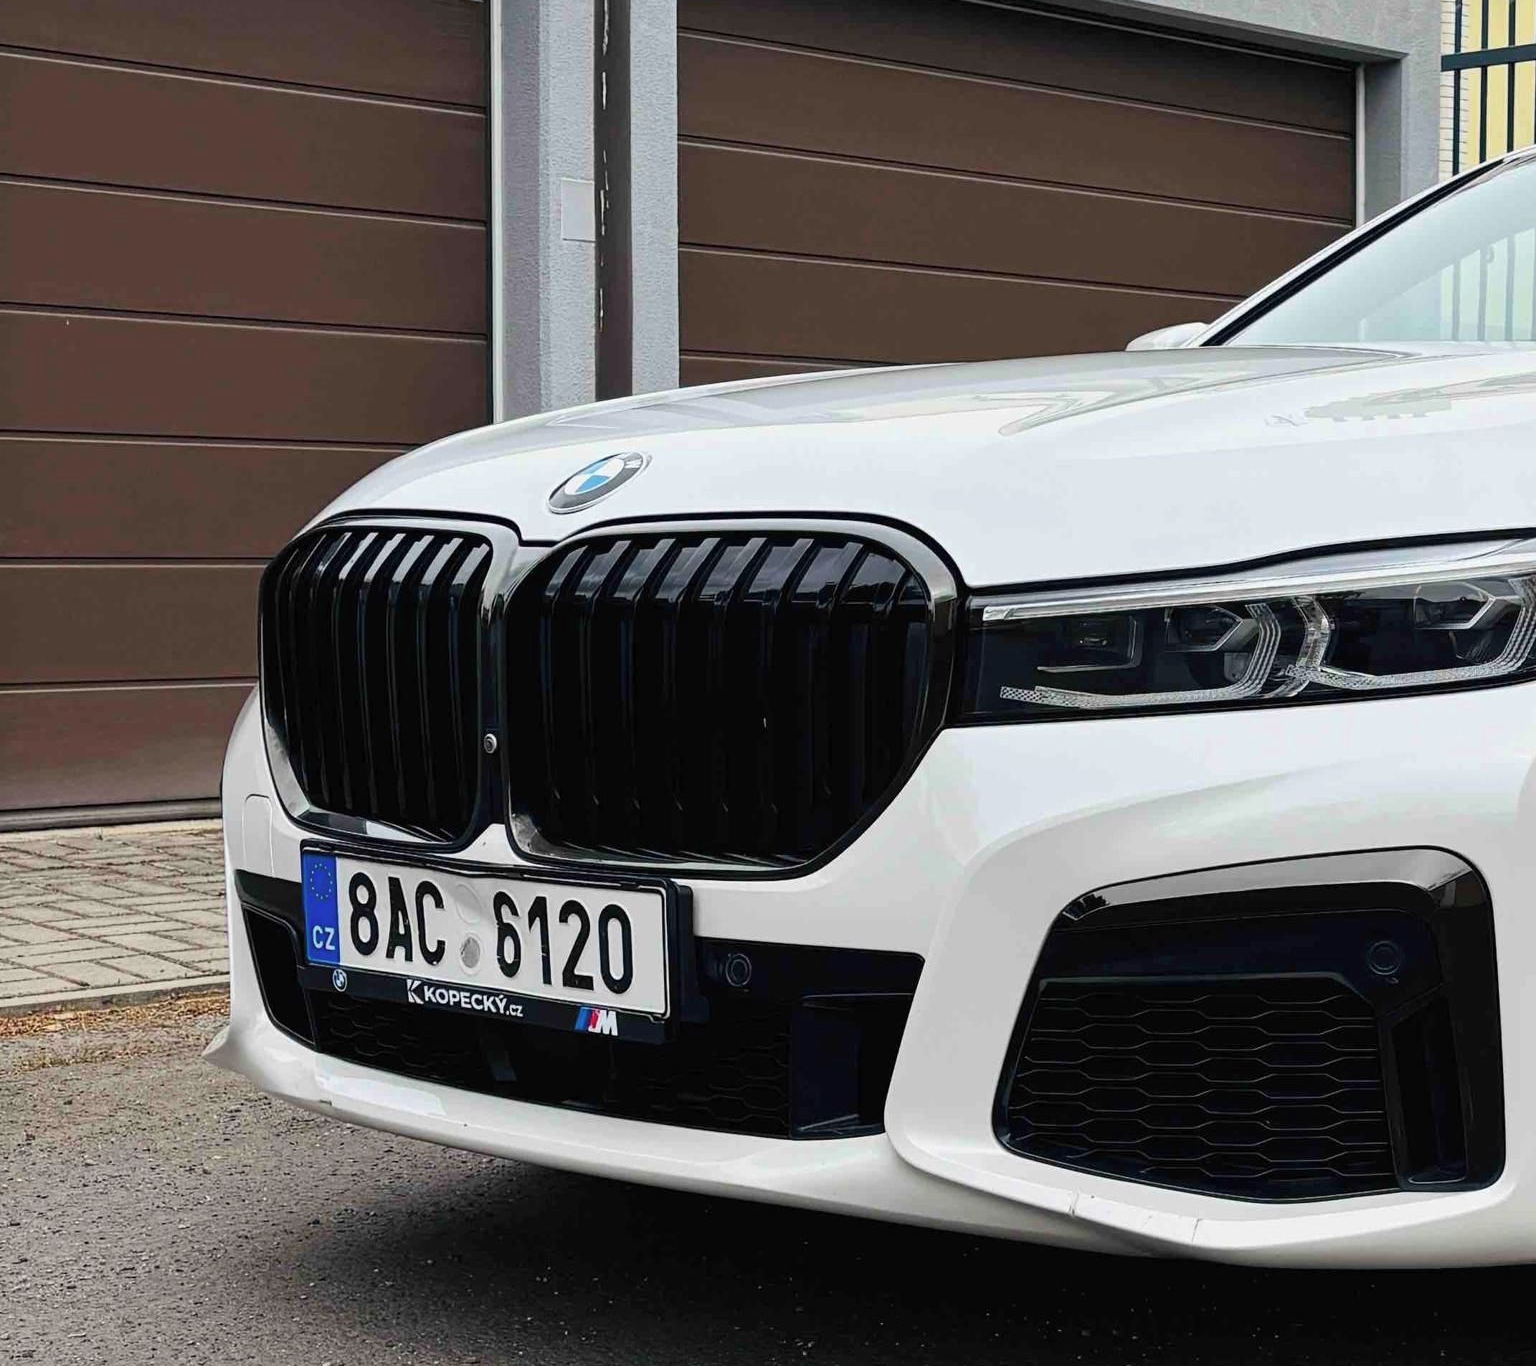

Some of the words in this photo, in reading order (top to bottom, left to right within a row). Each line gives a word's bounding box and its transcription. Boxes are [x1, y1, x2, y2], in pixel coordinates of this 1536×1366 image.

[313, 925, 336, 951] CZ
[348, 871, 446, 966] 8AC
[493, 891, 634, 995] 6120
